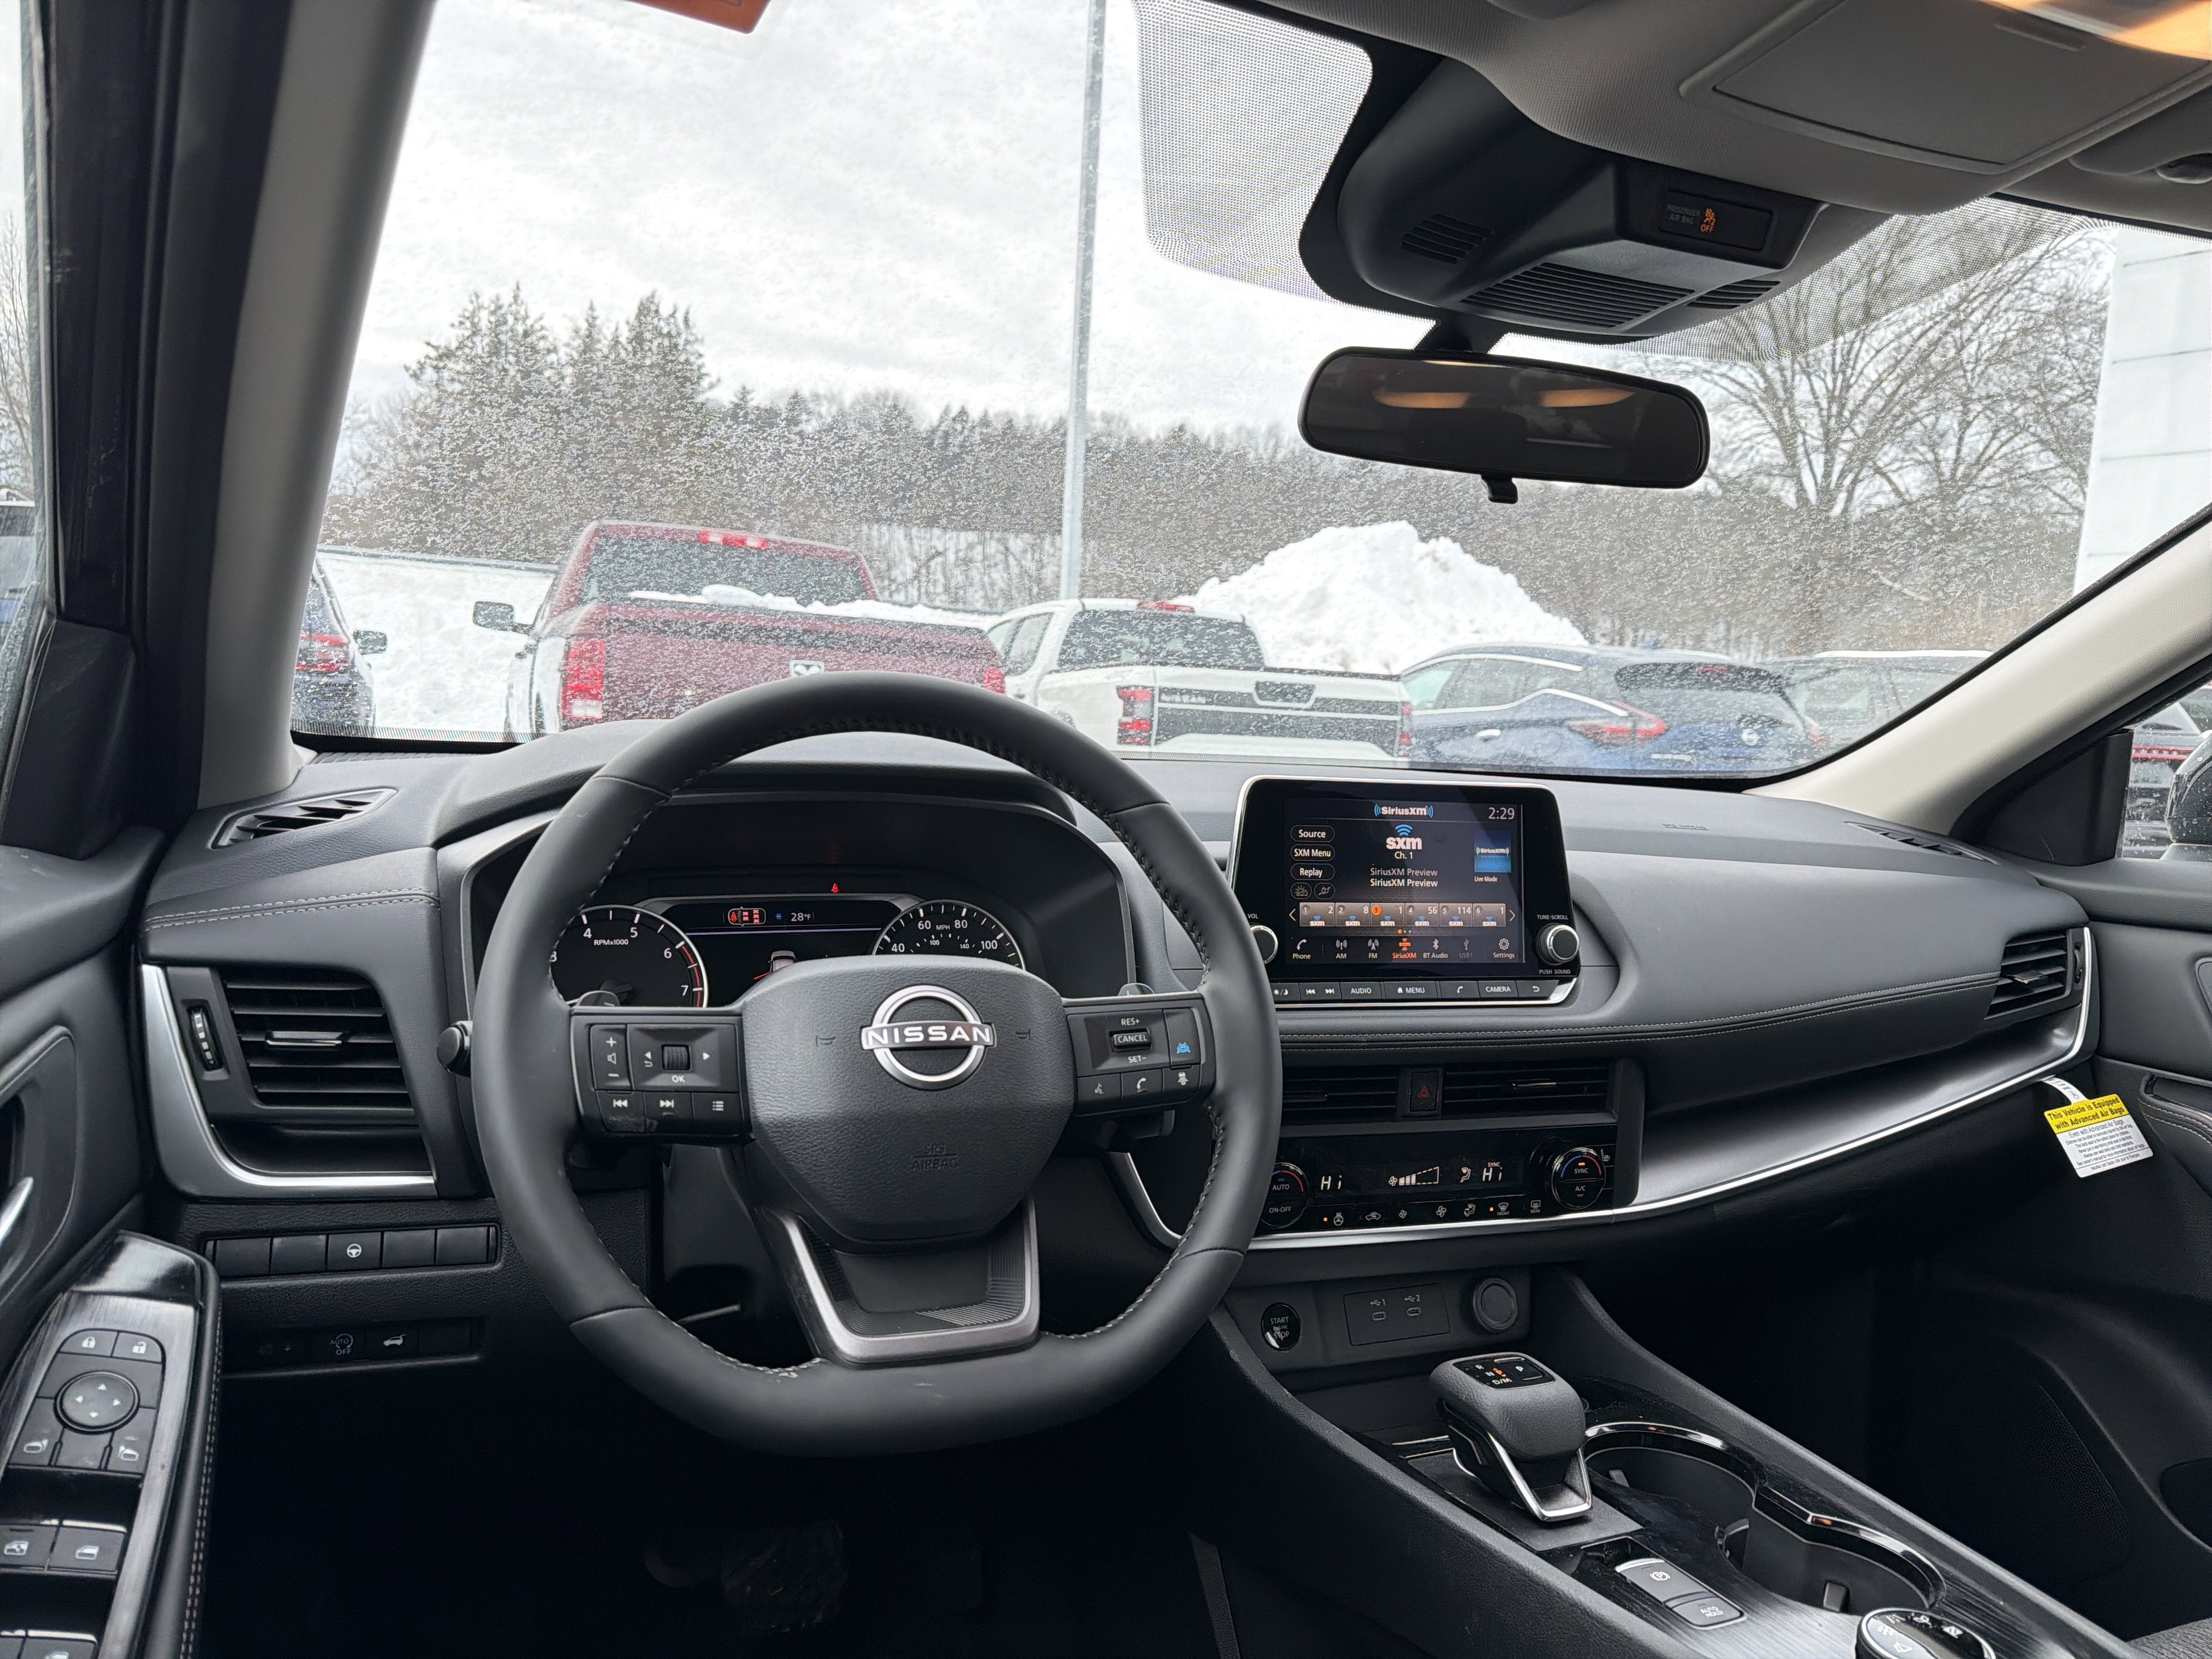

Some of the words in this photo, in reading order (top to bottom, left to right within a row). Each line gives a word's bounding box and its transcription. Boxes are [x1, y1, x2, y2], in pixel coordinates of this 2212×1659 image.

[1701, 224, 1714, 233] OFF
[1488, 807, 1515, 820] 2:29
[1299, 830, 1326, 838] Source
[1300, 868, 1323, 878] Replay
[1370, 868, 1405, 876] SiriusXM
[1407, 868, 1438, 877] Preview
[1370, 879, 1405, 887] SiriusXM
[1407, 879, 1438, 887] Preview
[1328, 906, 1334, 914] 2
[1363, 906, 1369, 914] 8
[1398, 906, 1402, 914] 1
[1427, 906, 1437, 915] 56
[1457, 906, 1471, 915] 114
[791, 912, 811, 922] 28°F
[918, 920, 931, 930] 60
[954, 919, 968, 929] 80
[583, 928, 592, 939] 4
[630, 927, 638, 938] 5
[891, 943, 905, 952] 40
[980, 940, 998, 950] 100
[664, 947, 672, 959] 6
[680, 985, 689, 996] 7
[1120, 1018, 1140, 1026] RES+
[867, 1025, 991, 1046] NISSAN
[1117, 1034, 1148, 1043] CANCEL
[672, 1075, 686, 1083] OK
[2047, 1111, 2063, 1121] This
[2063, 1105, 2085, 1117] Vehicle
[2092, 1096, 2120, 1109] Equipped
[2055, 1120, 2070, 1130] with
[2070, 1113, 2100, 1126] Advanced
[2109, 1107, 2125, 1115] Bags
[1270, 1316, 1289, 1325] START
[1274, 1330, 1290, 1339] STOP
[1700, 1606, 1719, 1614] AUTO
[1705, 1610, 1724, 1618] HOLD
